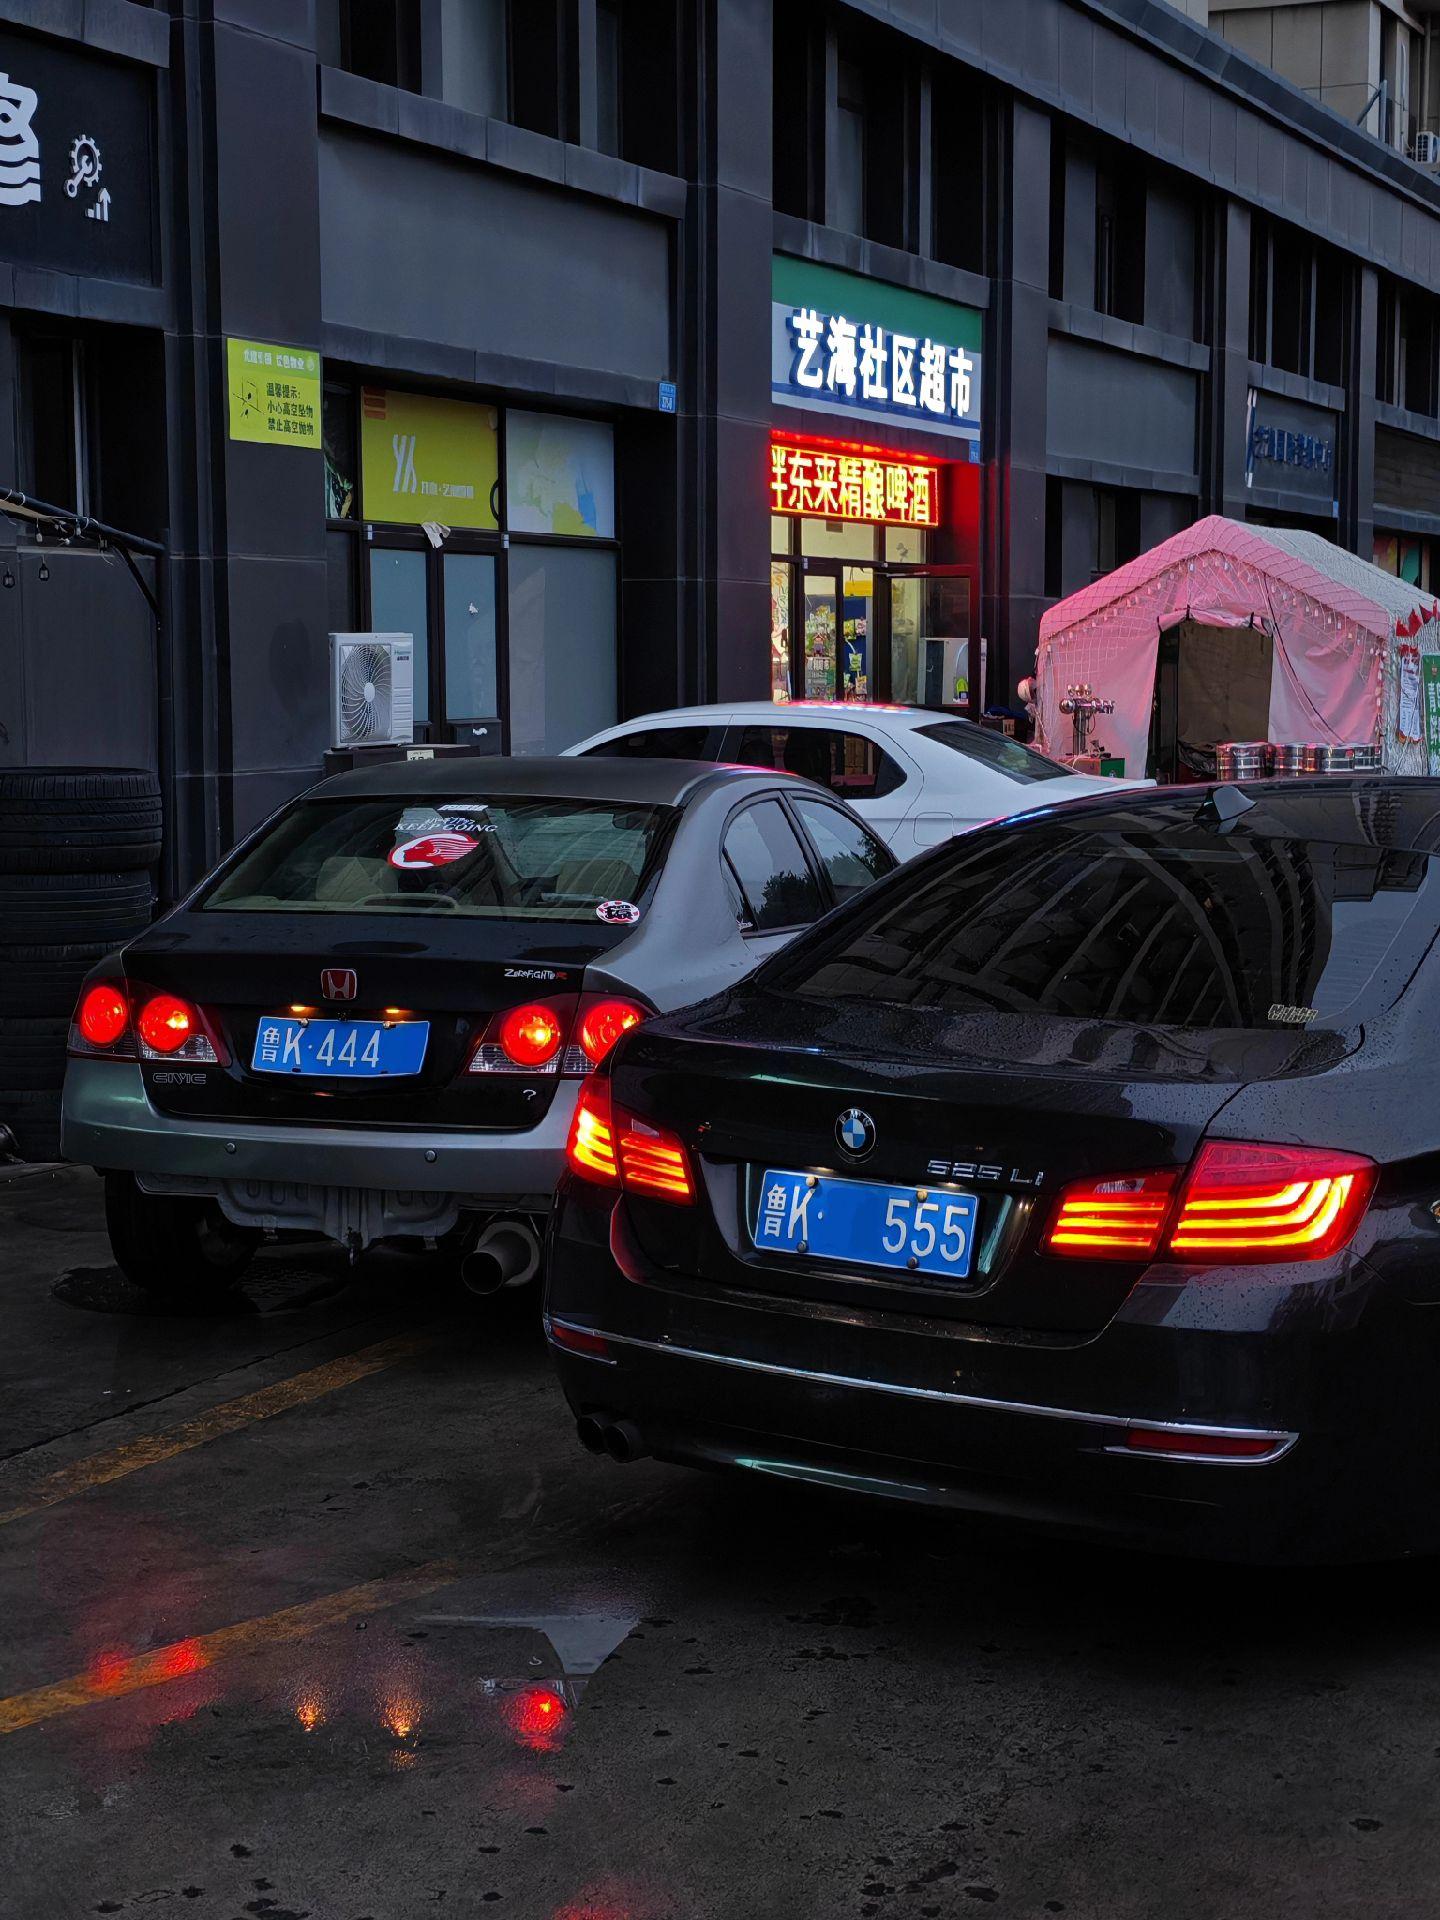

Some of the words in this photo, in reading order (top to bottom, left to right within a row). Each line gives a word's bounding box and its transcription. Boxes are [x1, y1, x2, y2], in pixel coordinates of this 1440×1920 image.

[790, 308, 973, 417] 艺海社区超市
[267, 400, 314, 418] 小心高空坠物
[268, 417, 314, 436] 禁止高空抛物
[152, 1072, 207, 1085] CIVIC
[927, 1159, 1003, 1180] 525
